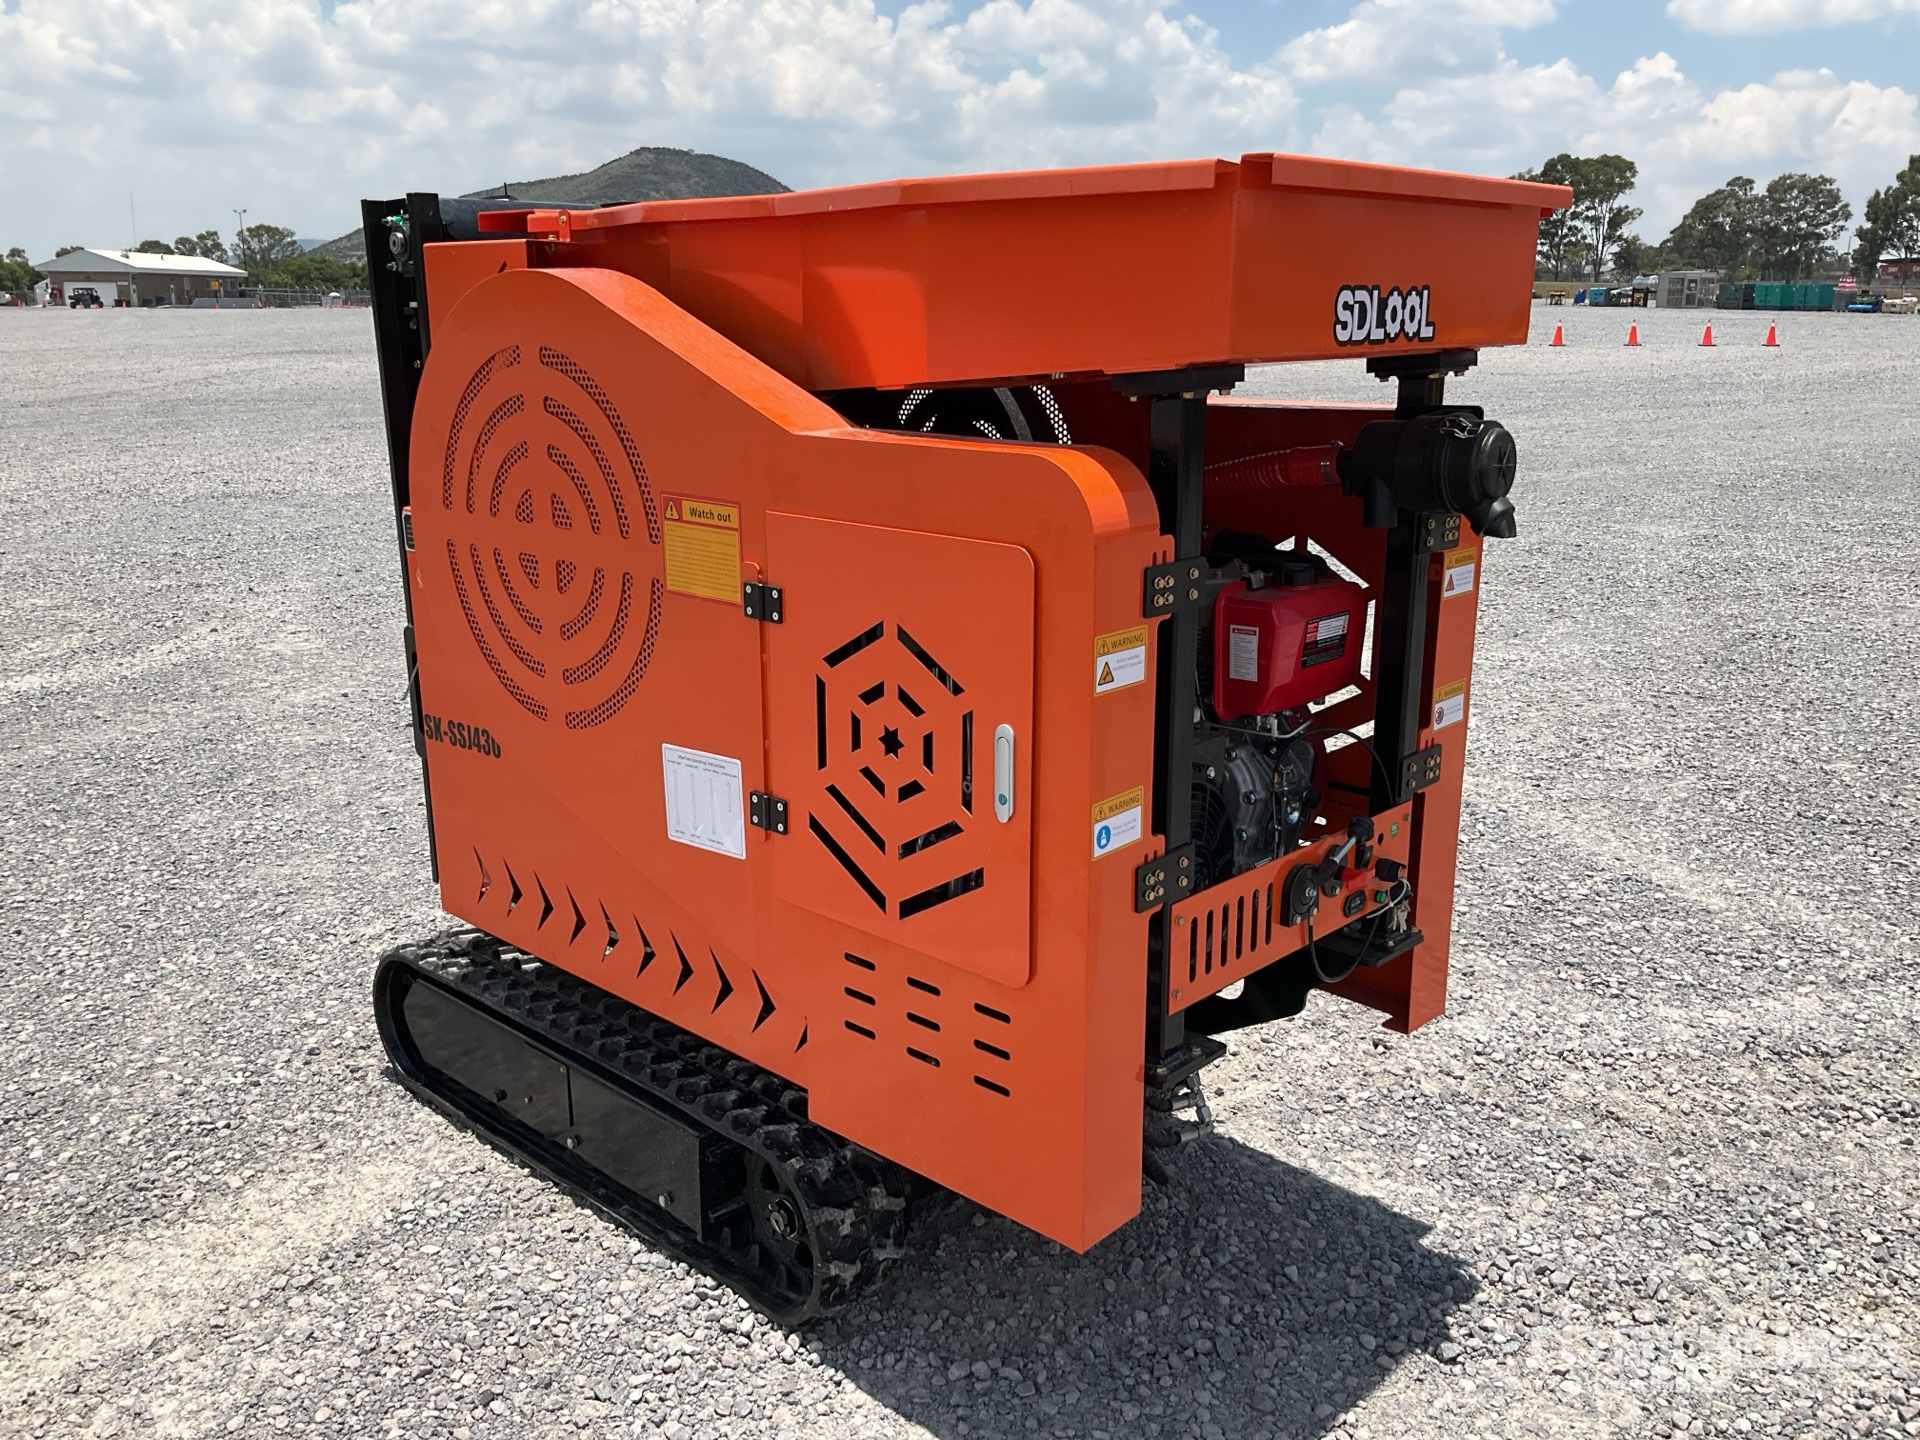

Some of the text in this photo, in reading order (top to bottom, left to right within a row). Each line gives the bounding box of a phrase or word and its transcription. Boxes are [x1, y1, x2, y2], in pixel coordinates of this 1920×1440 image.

[1334, 287, 1434, 344] SDLOOL
[689, 507, 731, 523] Watch out
[1111, 633, 1143, 649] WARNING
[1108, 794, 1140, 813] WARNING
